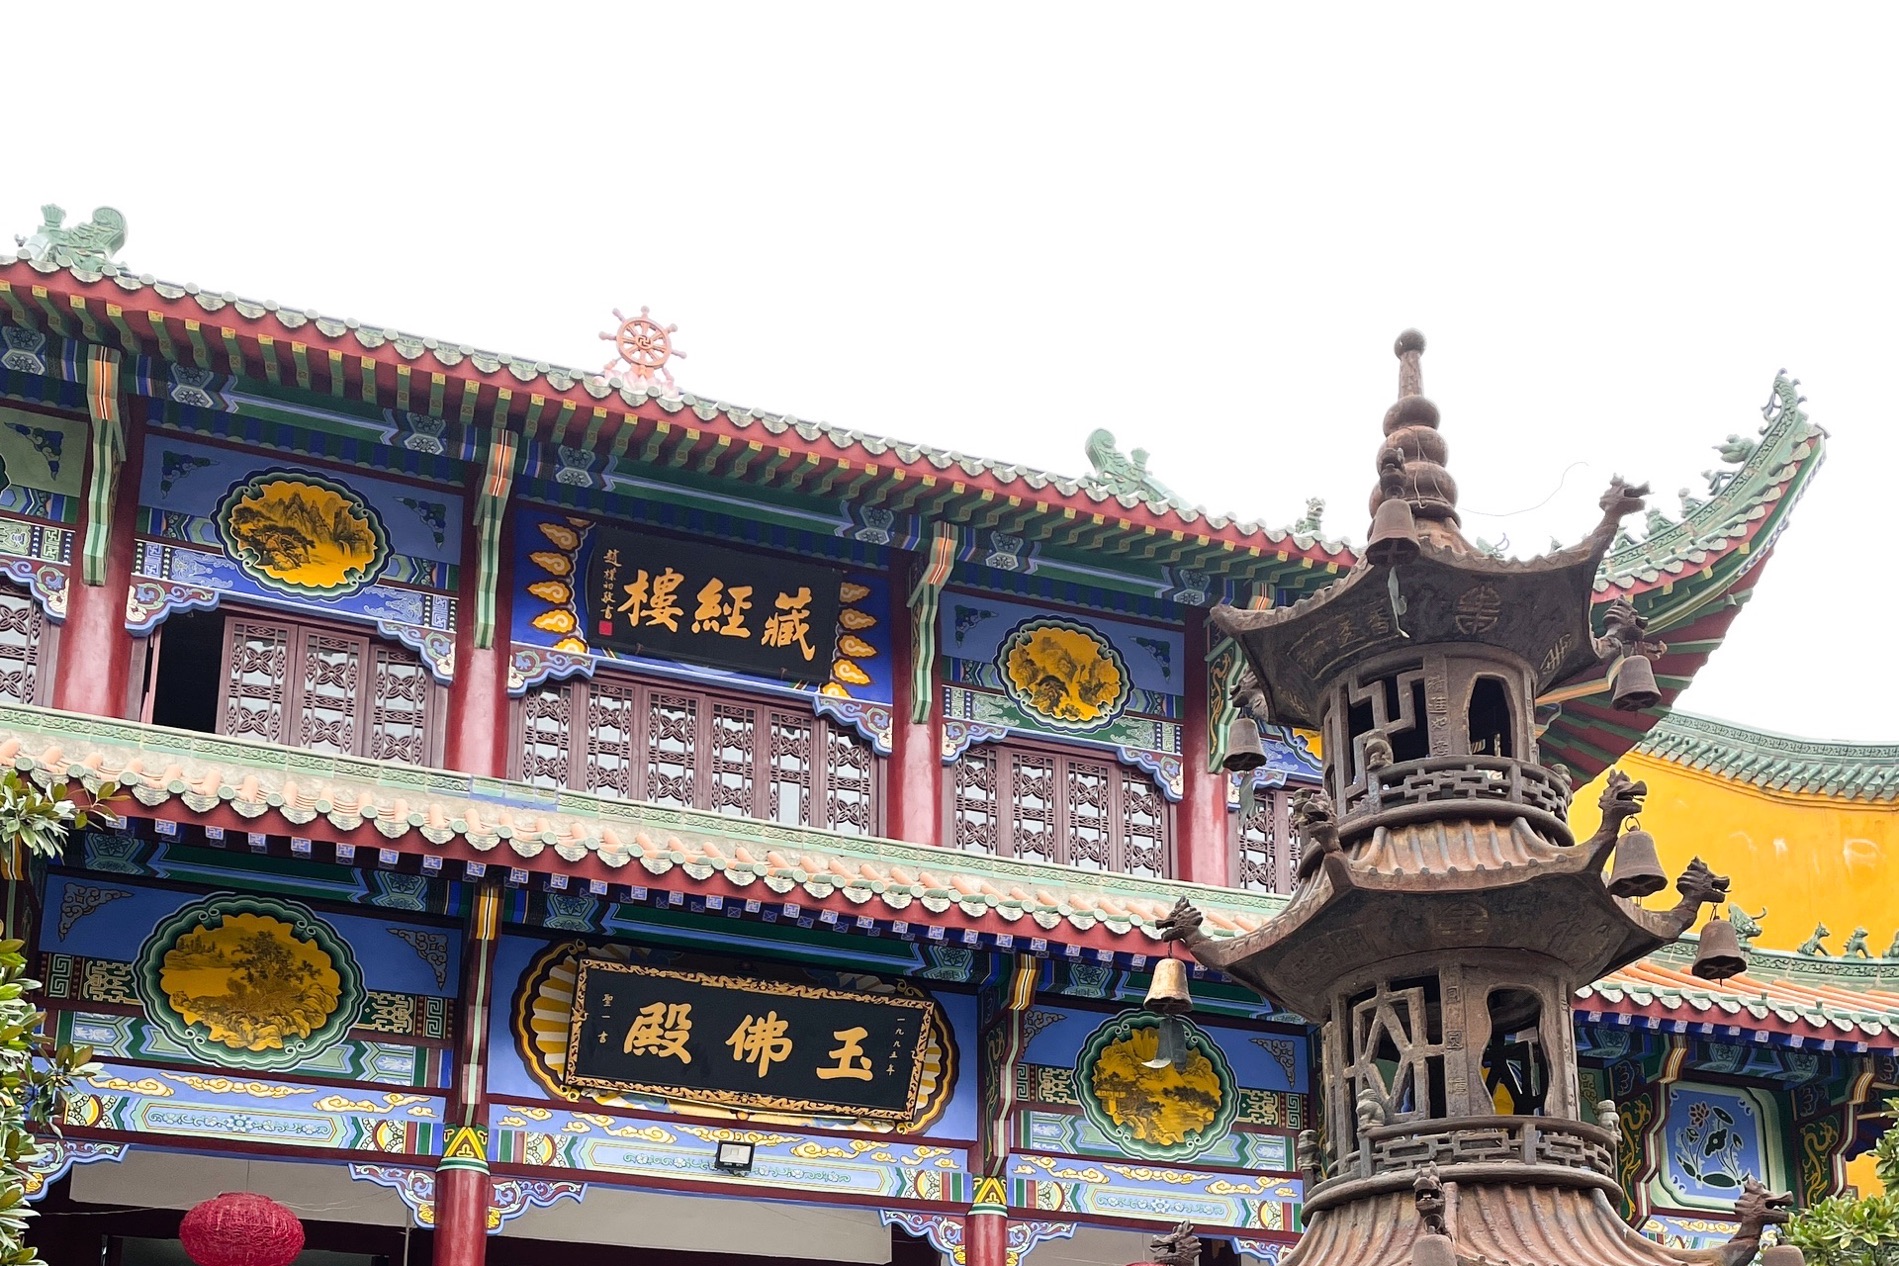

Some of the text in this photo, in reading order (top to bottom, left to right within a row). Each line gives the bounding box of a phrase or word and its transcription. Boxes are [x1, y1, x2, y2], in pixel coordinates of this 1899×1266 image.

[618, 567, 815, 662] 藏經樓
[623, 1001, 873, 1082] 玉佛殿
